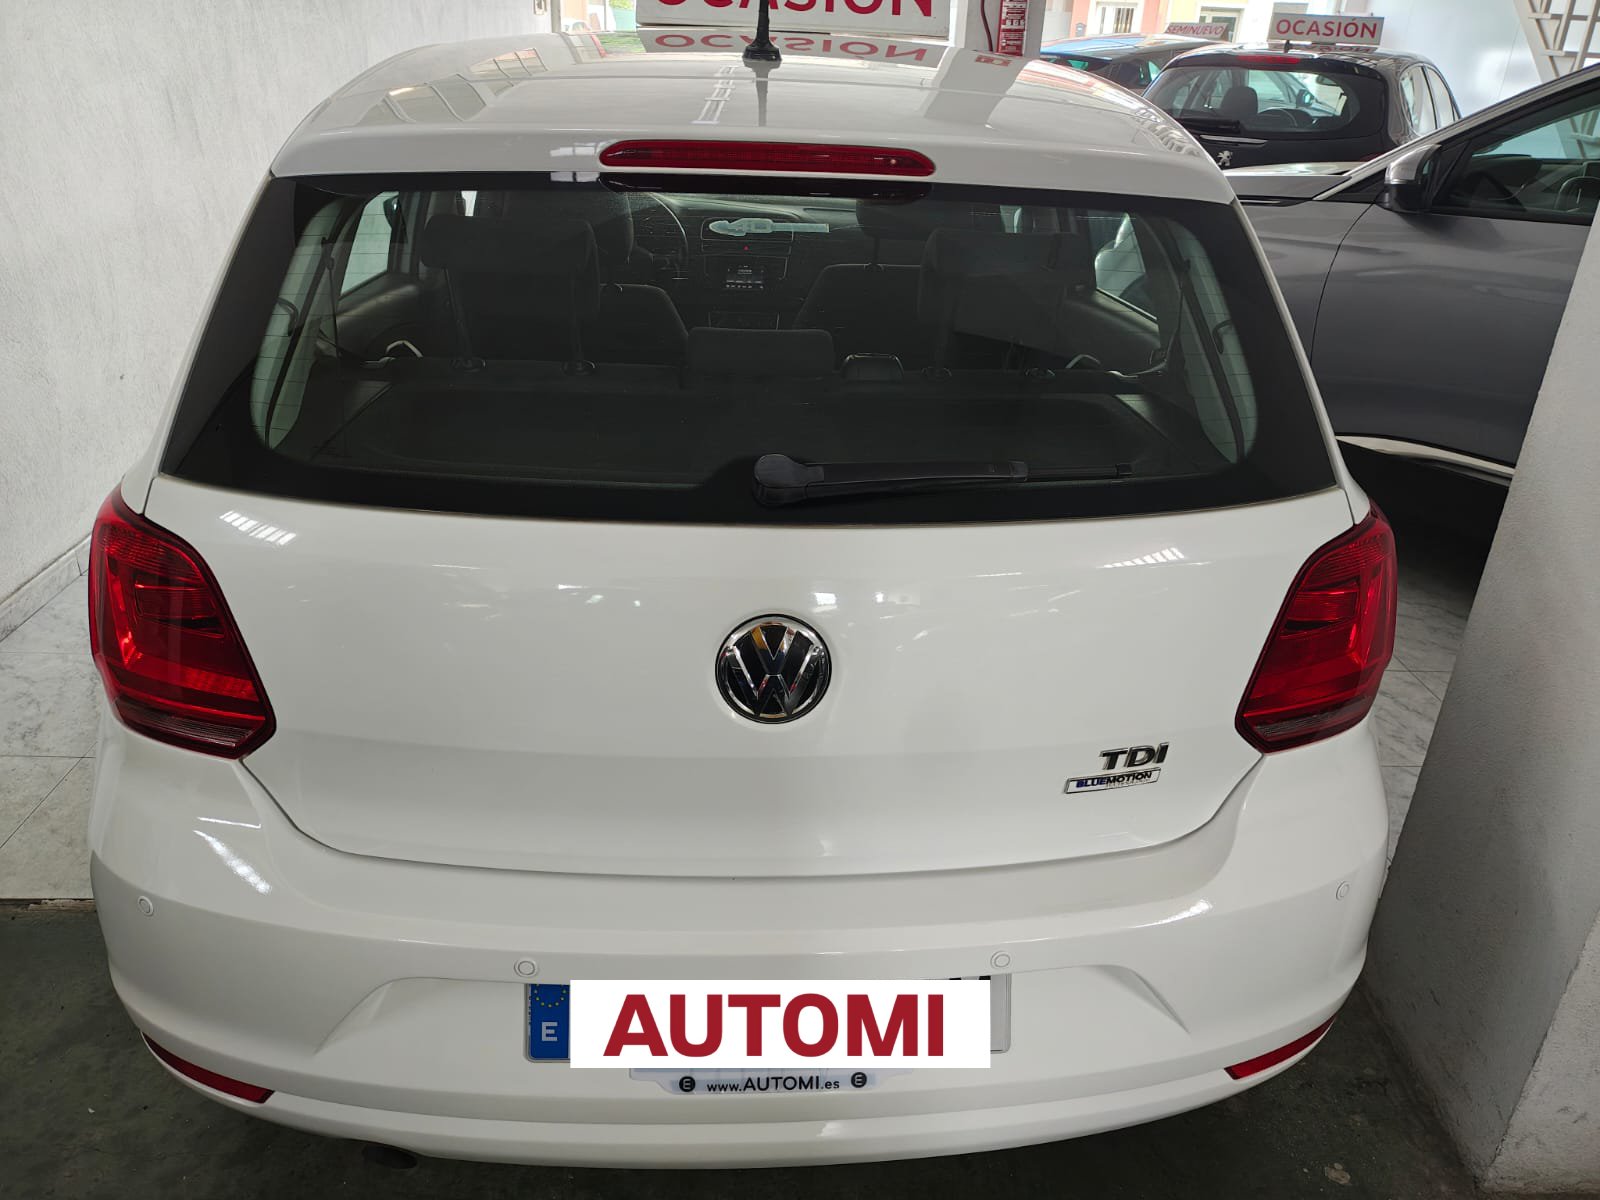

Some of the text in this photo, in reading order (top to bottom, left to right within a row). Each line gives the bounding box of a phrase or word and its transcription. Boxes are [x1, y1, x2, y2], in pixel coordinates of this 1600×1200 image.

[1165, 25, 1224, 36] SEMINUEVO
[1276, 18, 1377, 39] OCASIÓN
[1099, 741, 1169, 771] TDI
[1076, 771, 1153, 788] BLUEMOTION
[541, 1021, 558, 1042] E
[707, 1076, 840, 1092] www.AUTOMI.es
